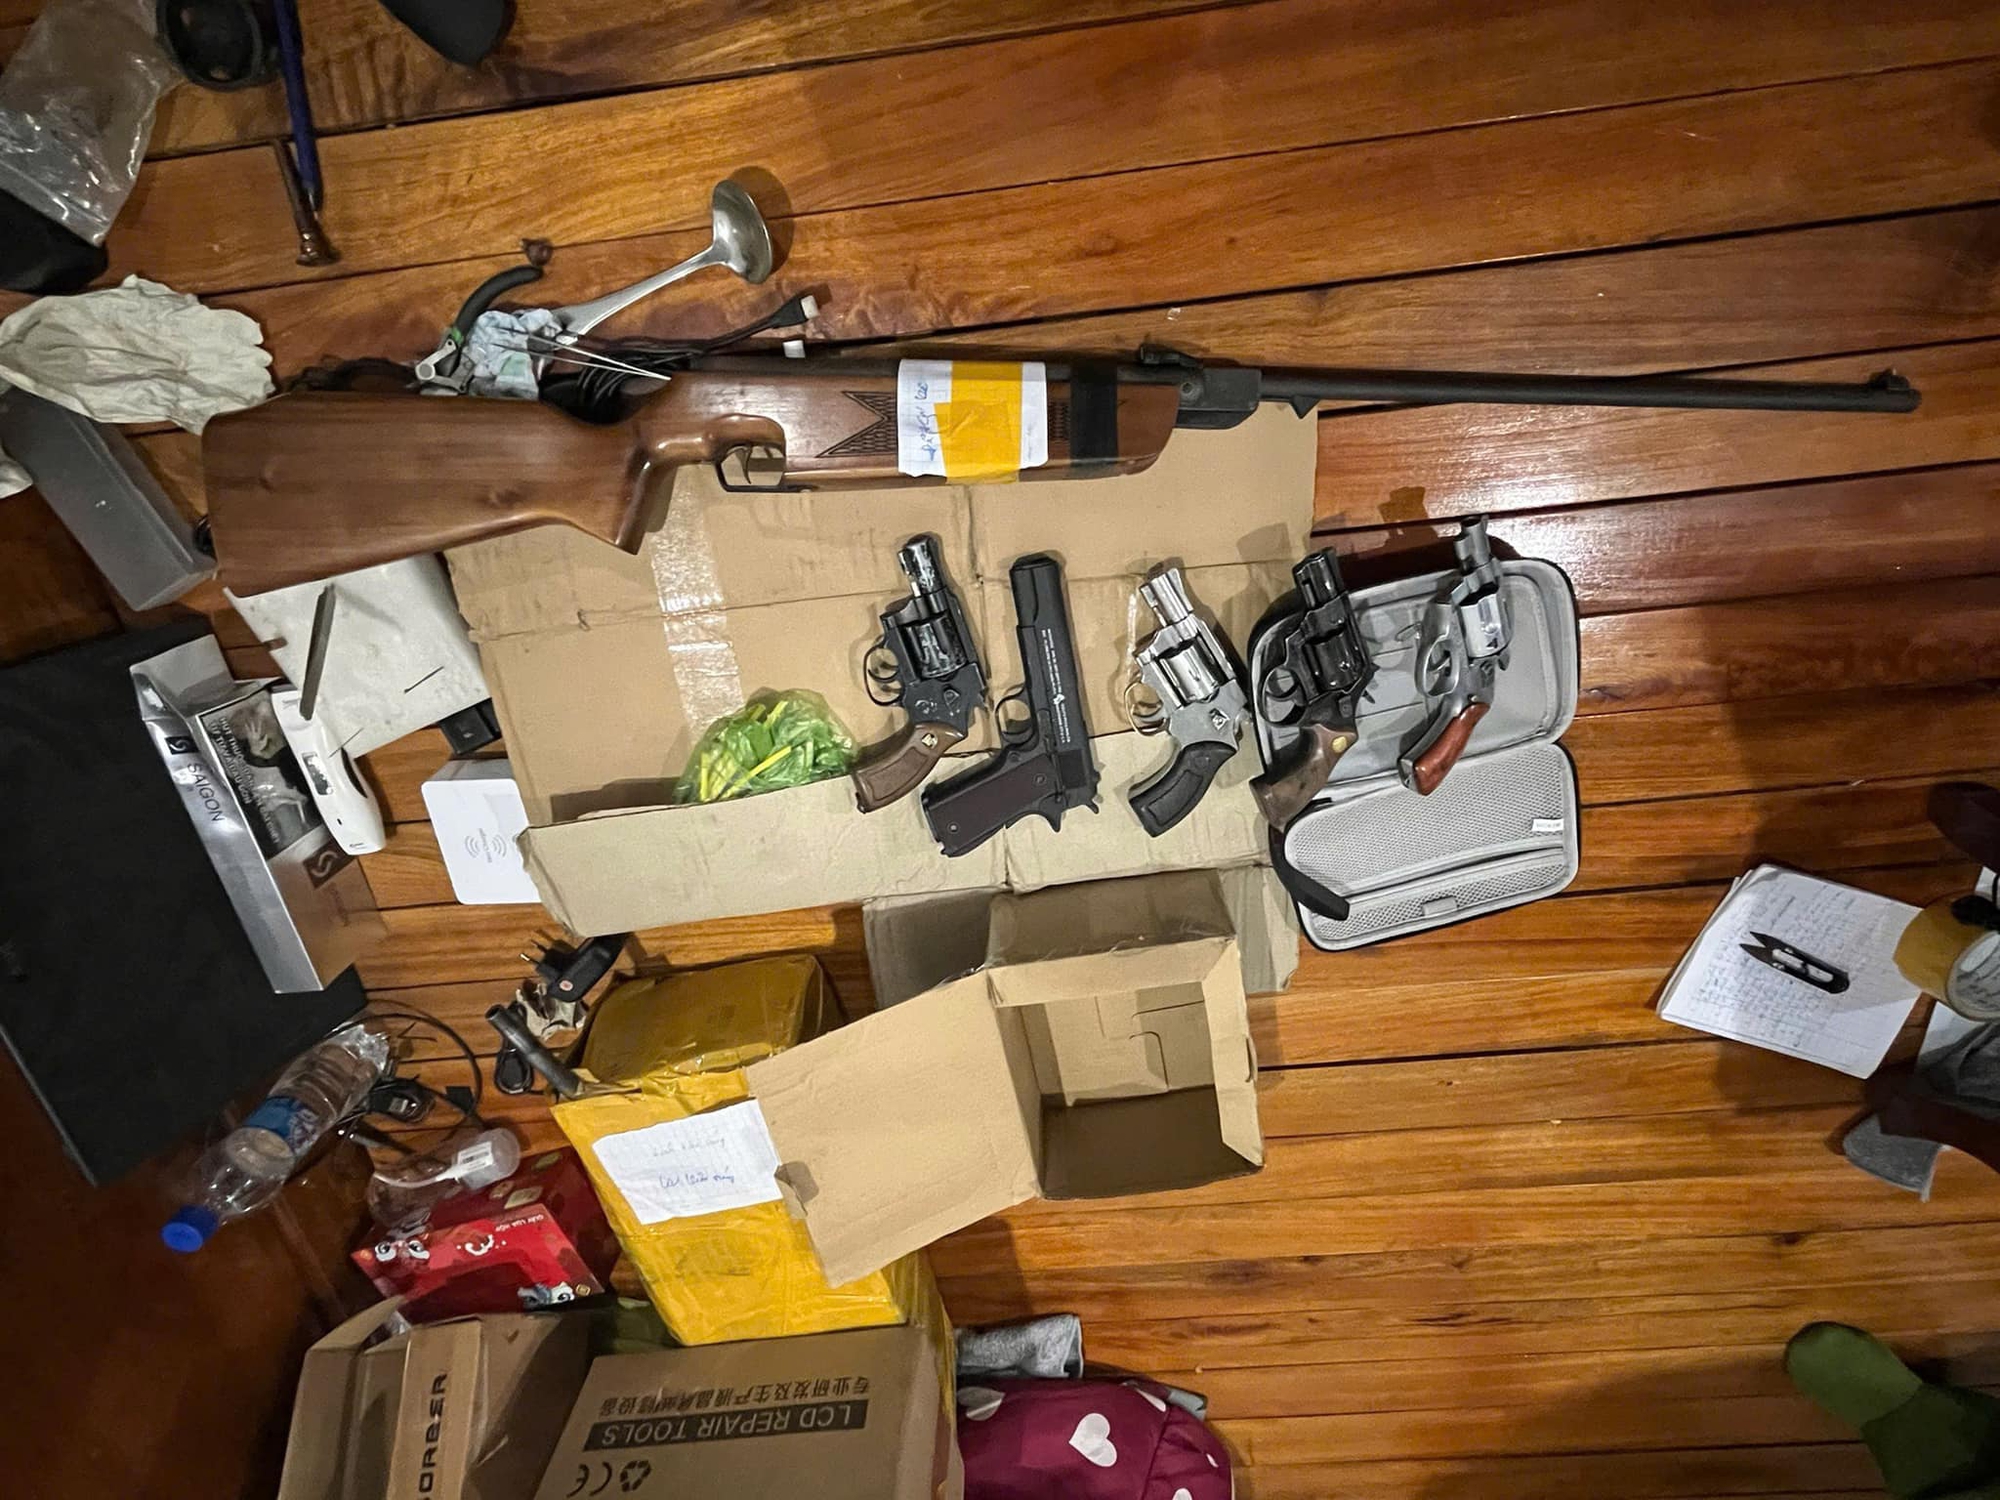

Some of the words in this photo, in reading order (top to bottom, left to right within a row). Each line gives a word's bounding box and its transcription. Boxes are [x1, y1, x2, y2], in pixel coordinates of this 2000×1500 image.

[187, 763, 225, 821] SAIGON
[699, 1407, 790, 1439] REPAIR
[801, 1403, 851, 1427] LCD
[601, 1420, 686, 1446] TOOLS
